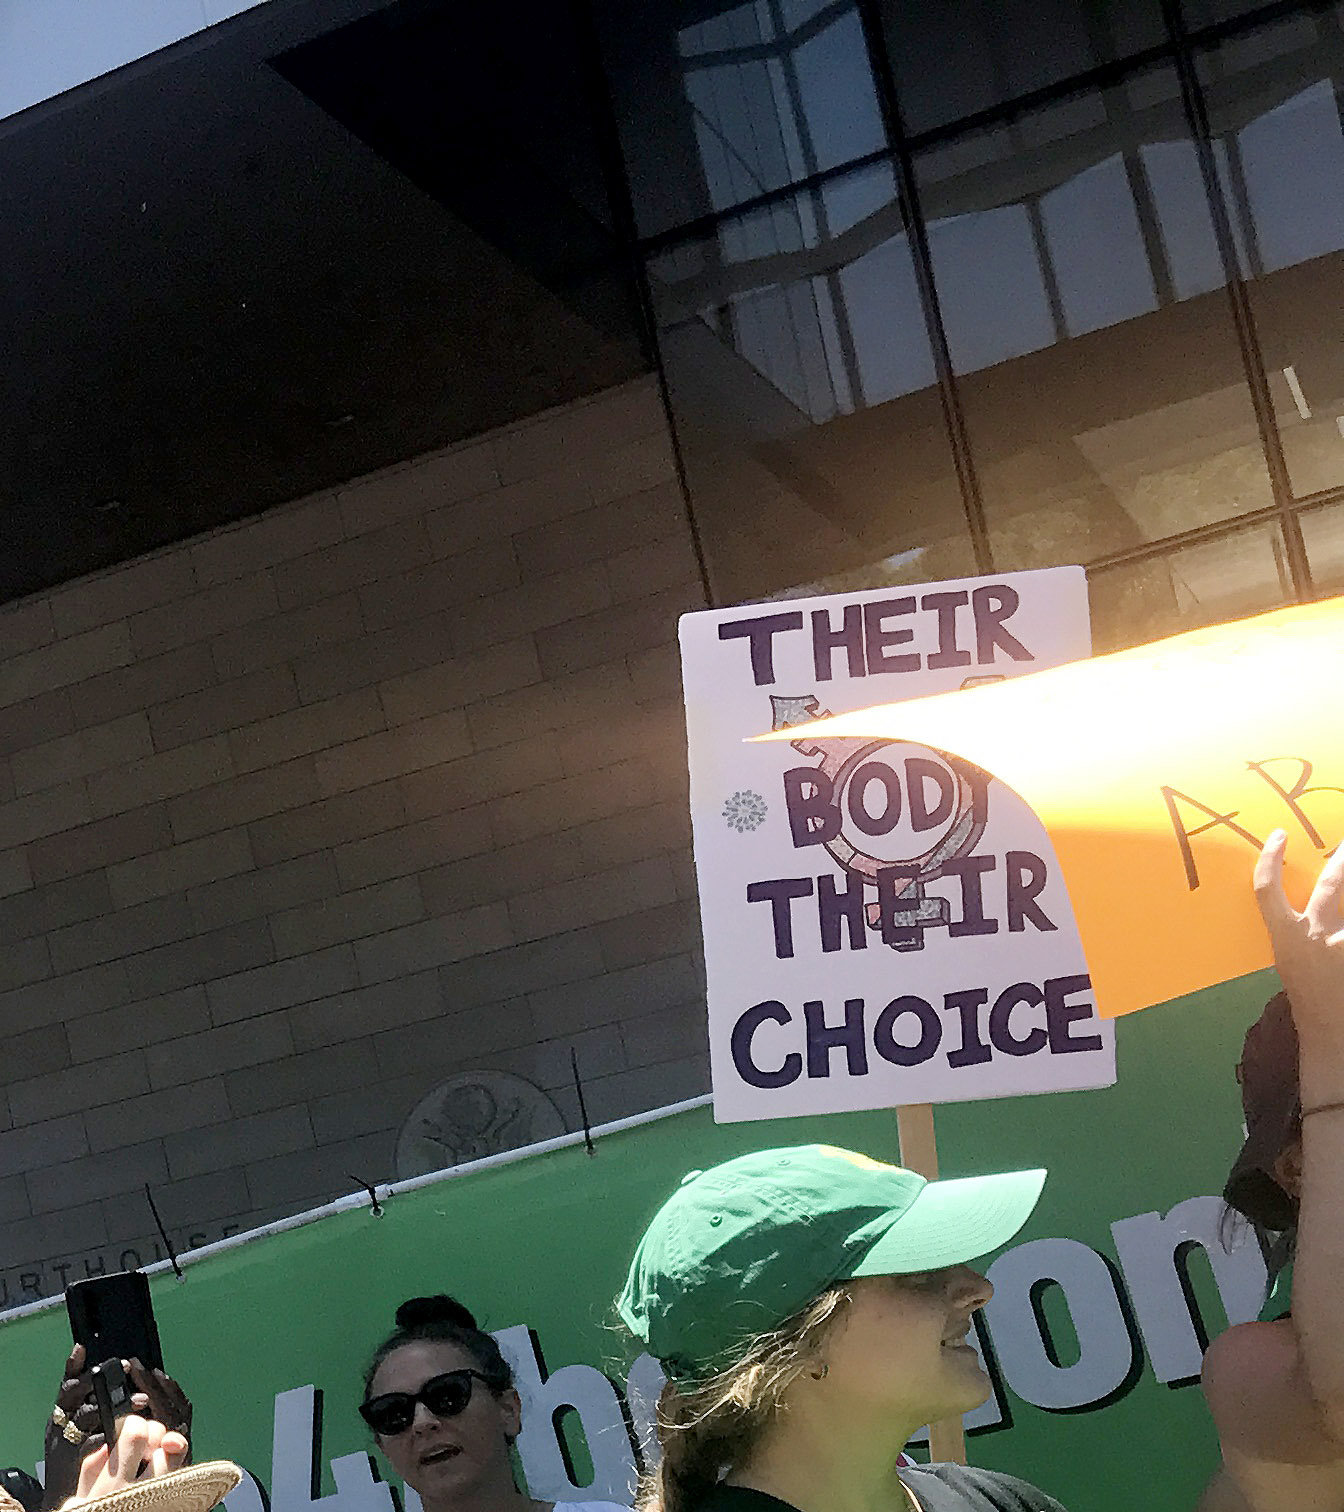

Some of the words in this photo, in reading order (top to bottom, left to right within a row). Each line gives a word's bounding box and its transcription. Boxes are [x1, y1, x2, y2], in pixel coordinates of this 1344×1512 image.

[718, 584, 1035, 686] THEIR
[746, 850, 1058, 960] THEIR
[730, 973, 1104, 1090] CHOICE
